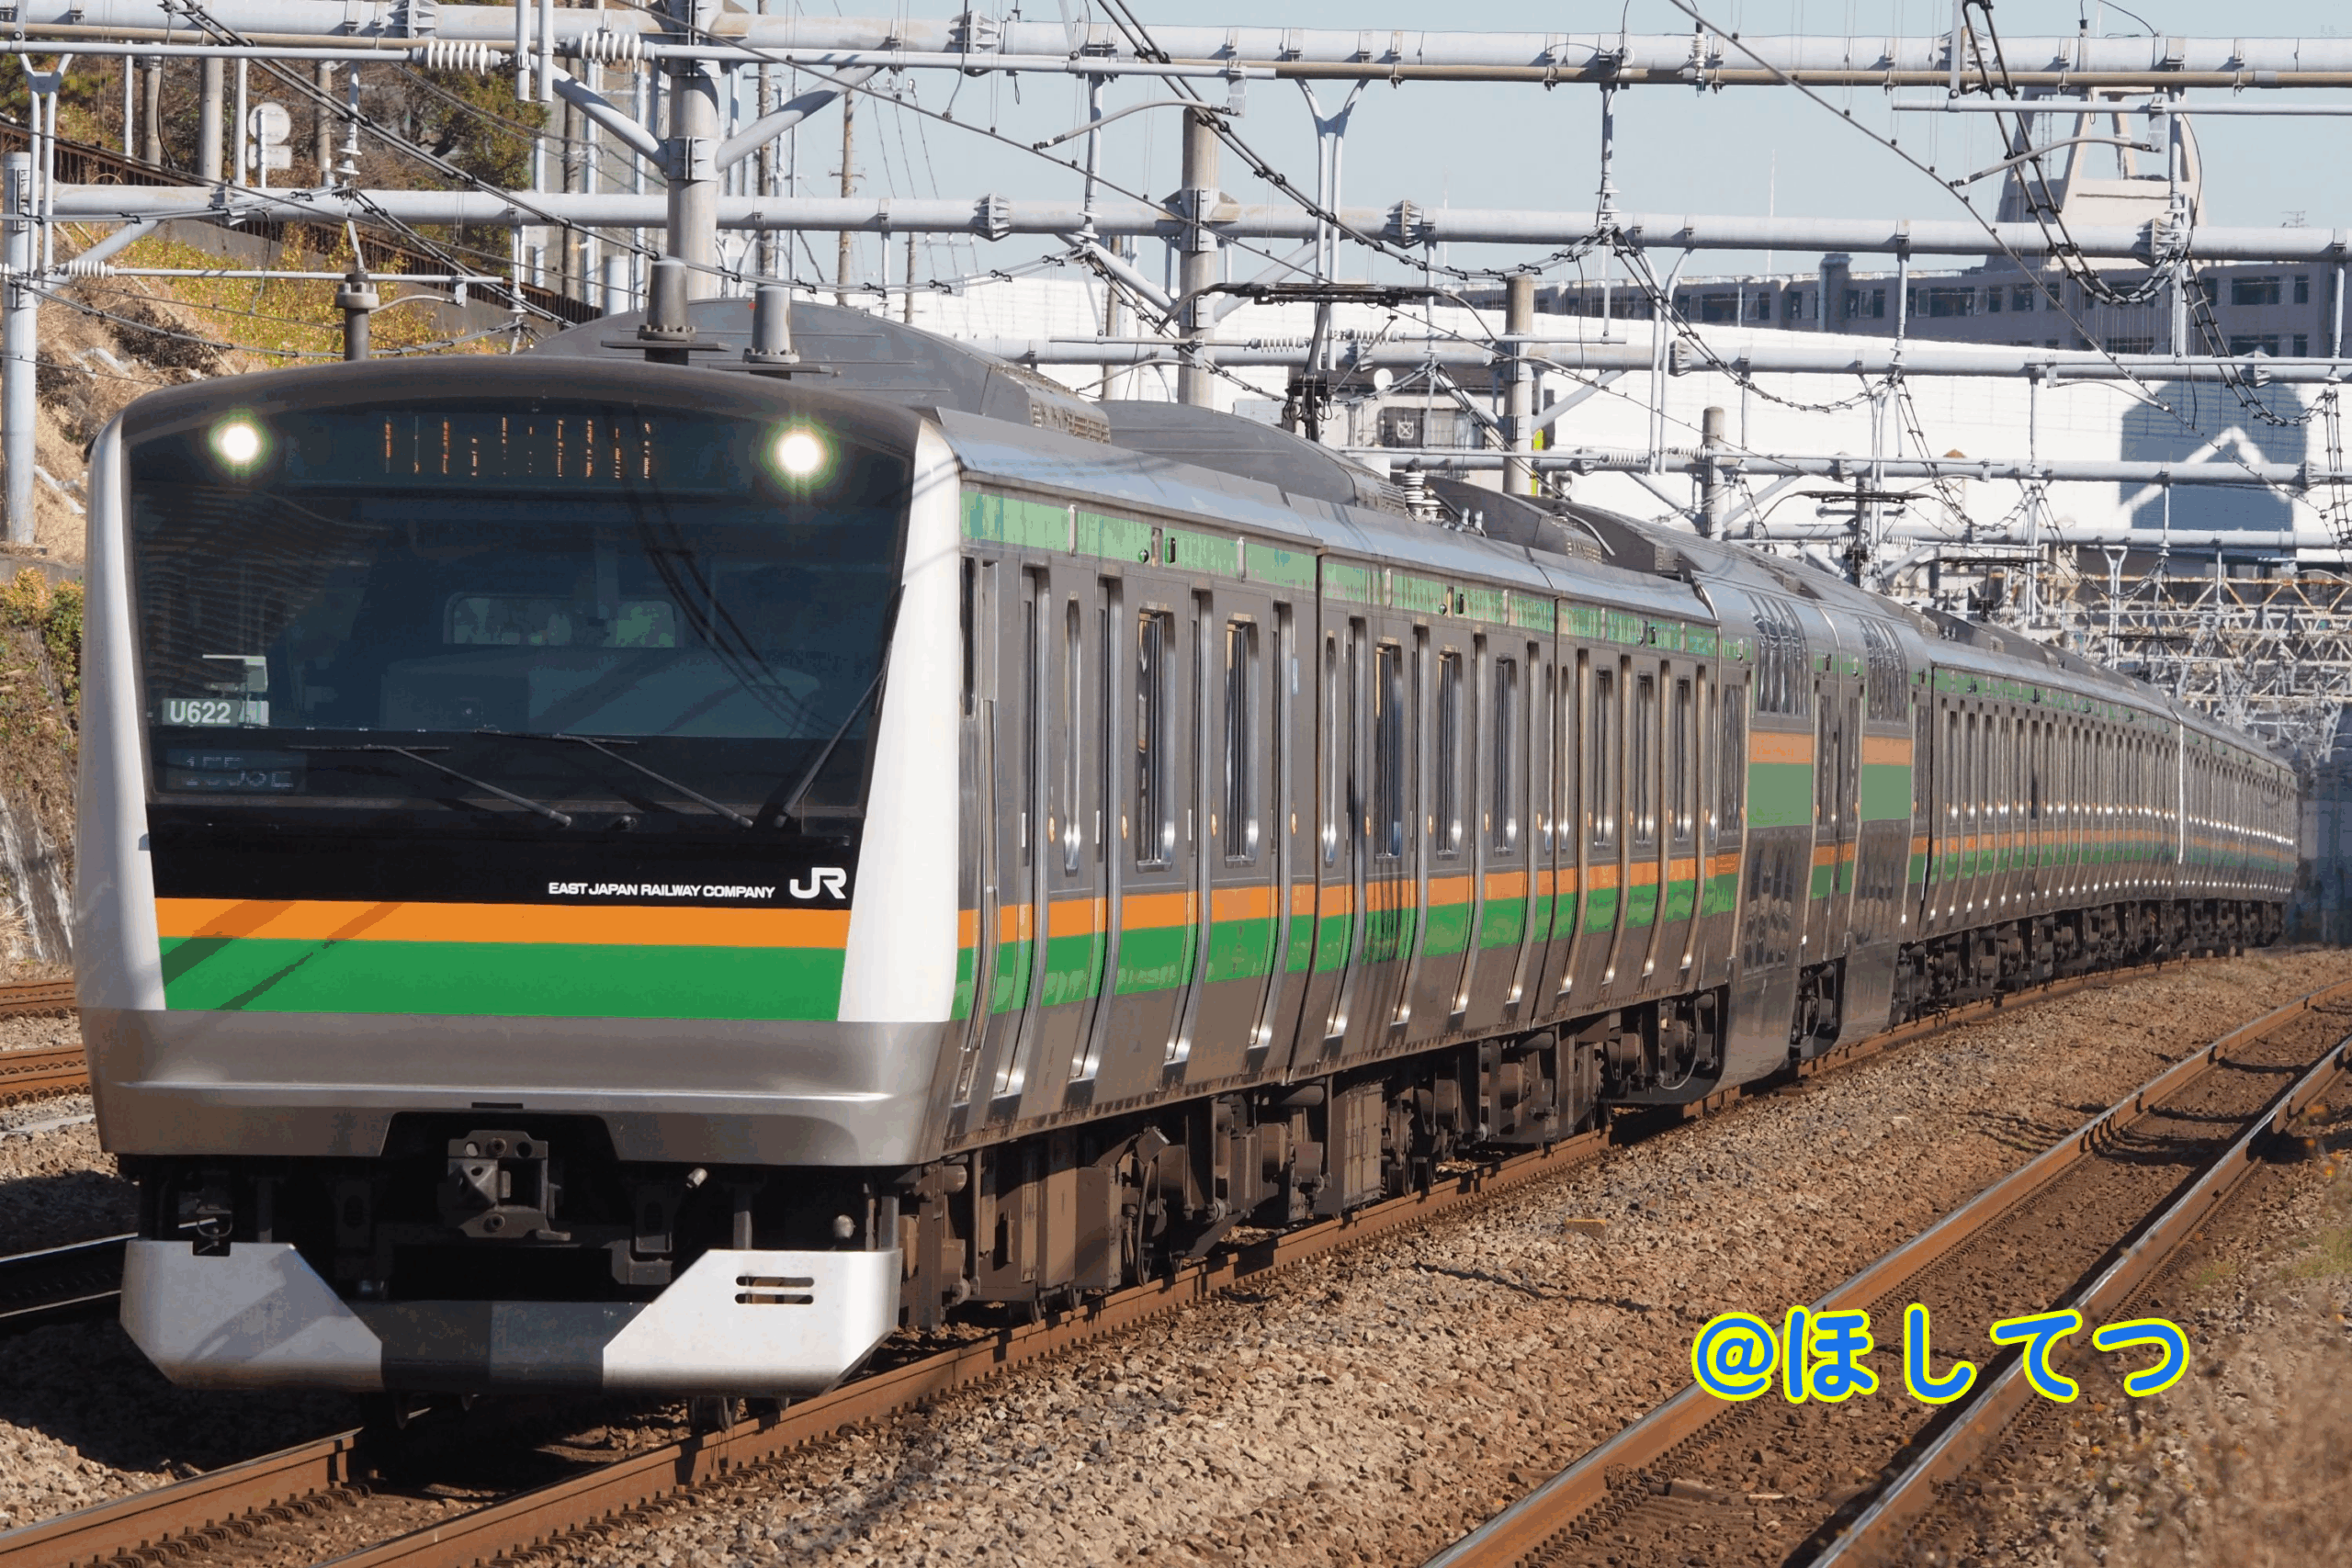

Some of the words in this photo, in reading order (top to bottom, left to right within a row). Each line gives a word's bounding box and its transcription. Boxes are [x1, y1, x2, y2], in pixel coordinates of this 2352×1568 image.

[169, 700, 232, 724] U622
[548, 882, 588, 895] EAST
[588, 883, 639, 896] JAPAN
[640, 884, 702, 897] RAILWAY
[702, 885, 775, 898] COMPANY
[789, 866, 847, 899] JR
